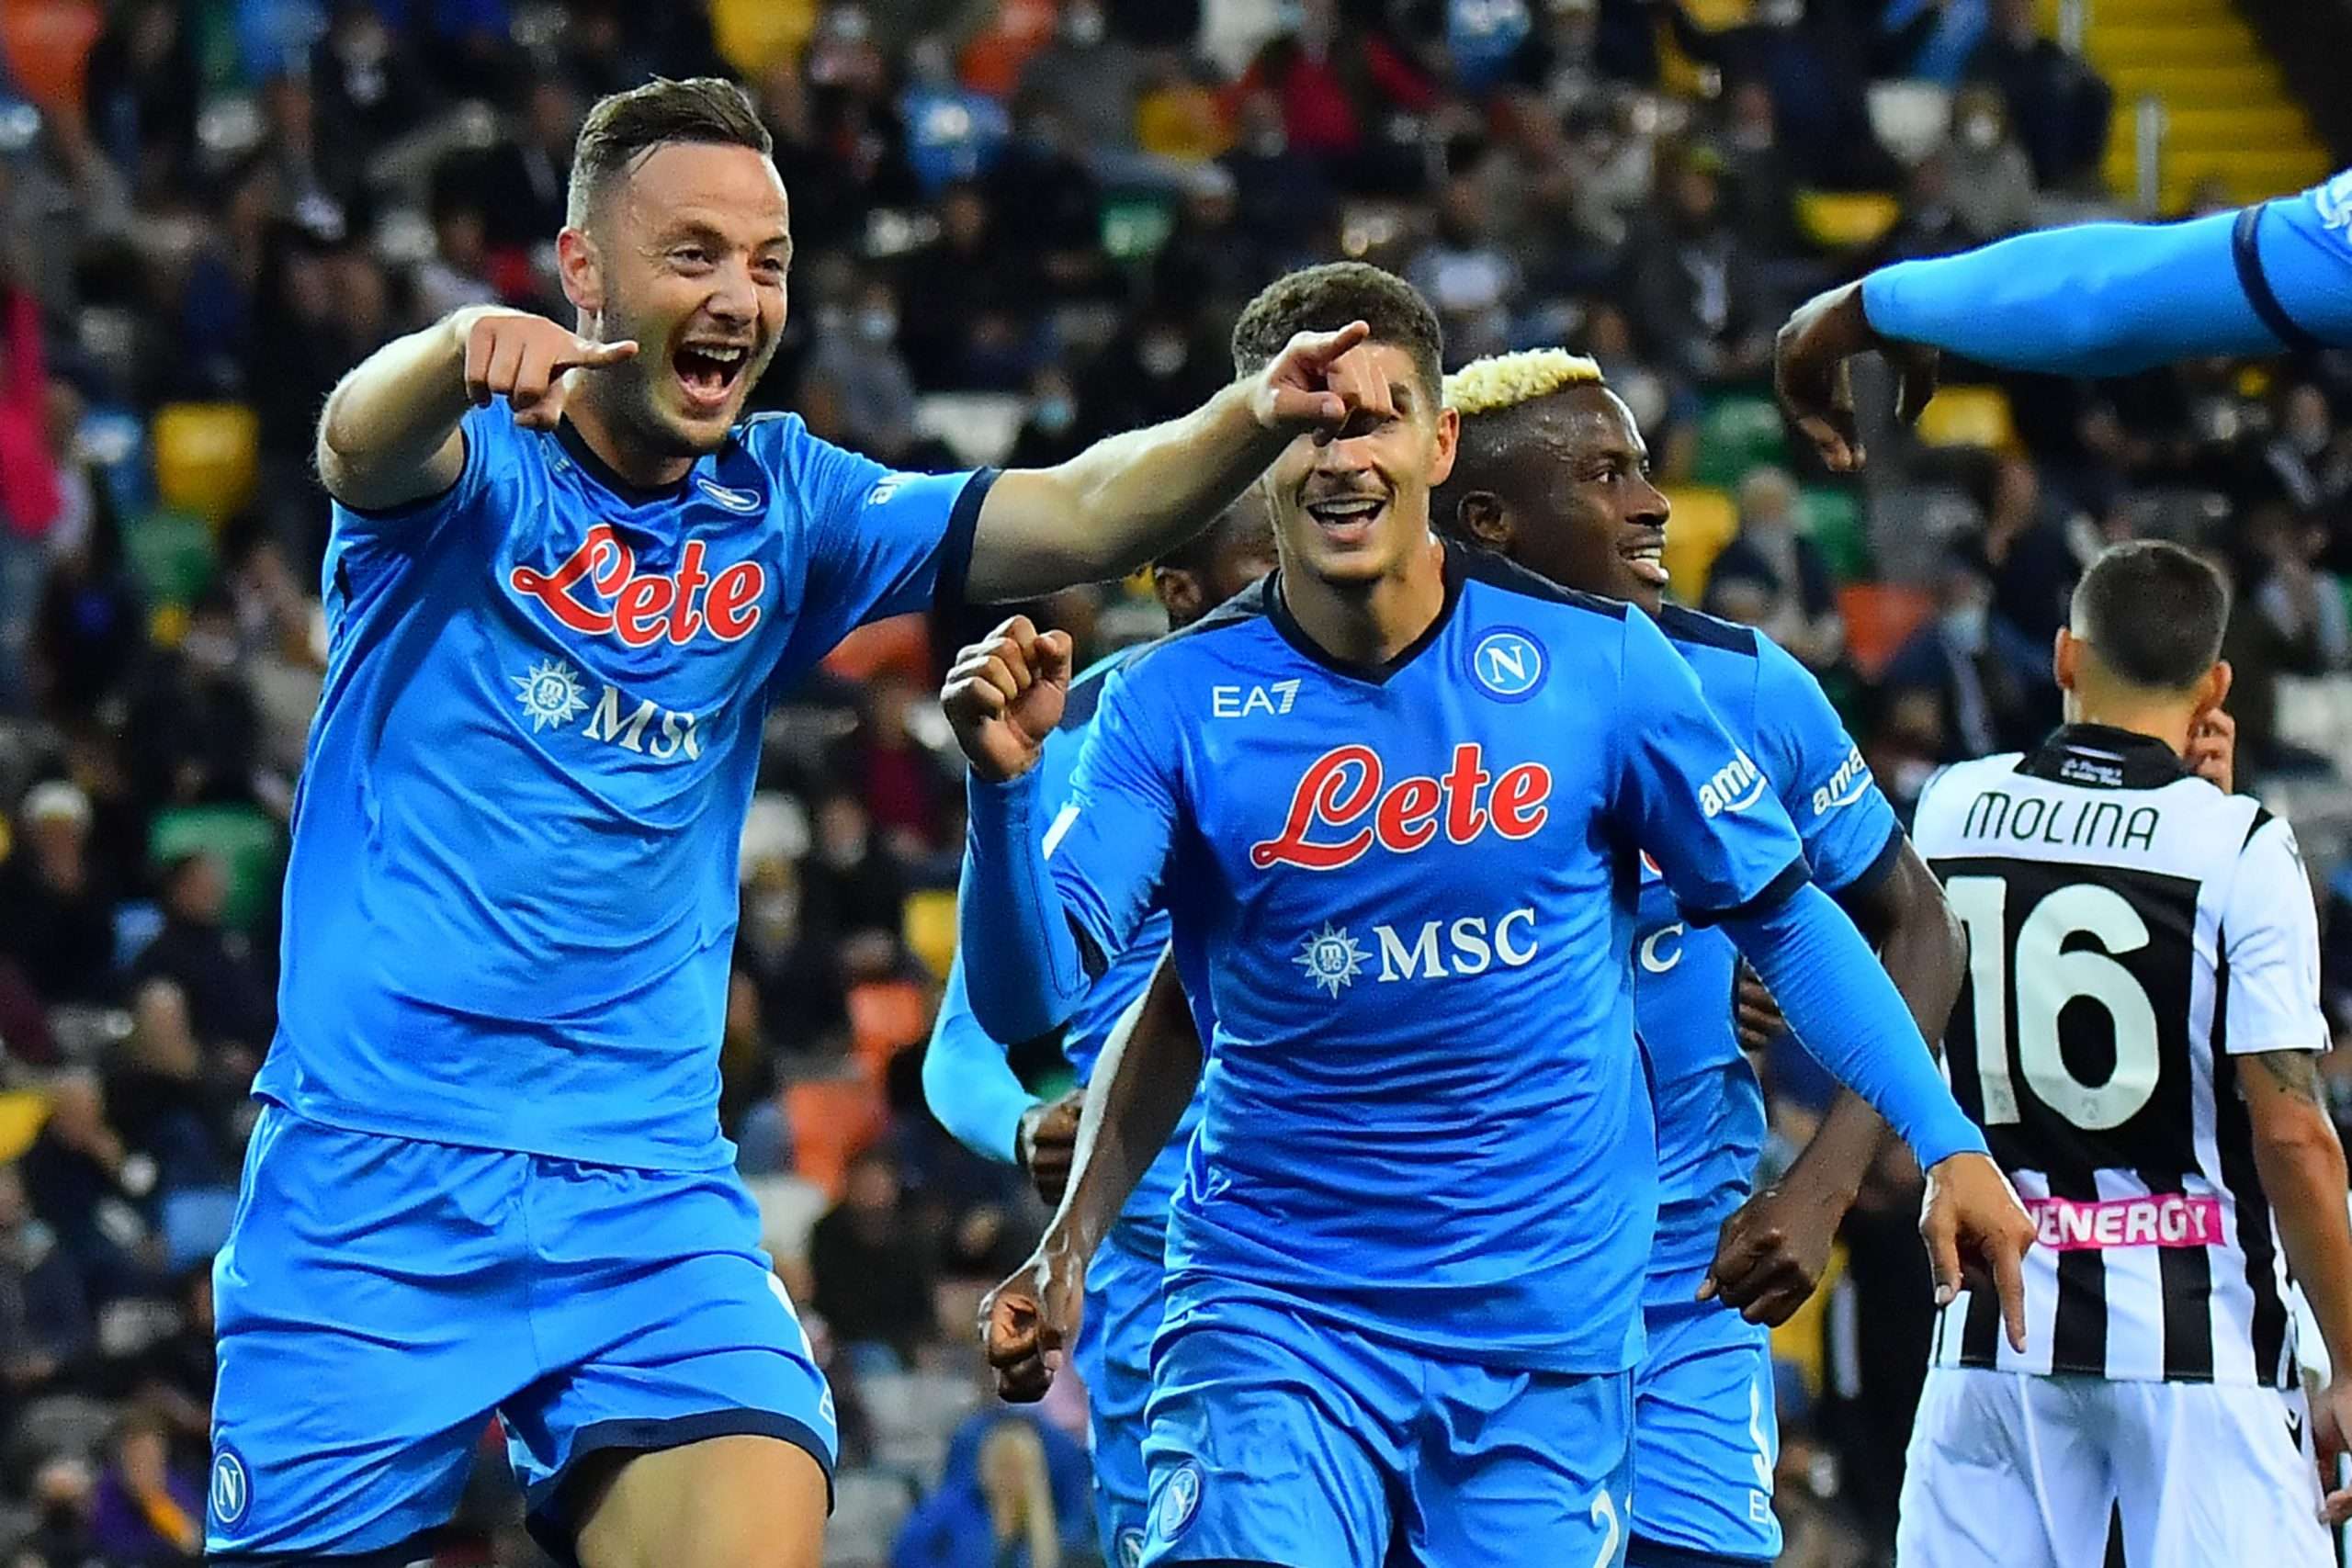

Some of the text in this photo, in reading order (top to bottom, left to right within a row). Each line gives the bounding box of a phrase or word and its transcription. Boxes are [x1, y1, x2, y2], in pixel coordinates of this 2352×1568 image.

[510, 523, 765, 648] Lete
[1213, 678, 1302, 718] EA7
[1486, 645, 1525, 683] N
[1250, 742, 1553, 872] Lete
[1962, 791, 2160, 852] MOLINA
[1373, 907, 1539, 983] MSC
[1947, 874, 2161, 1132] 16
[2031, 1197, 2207, 1246] ENERGY
